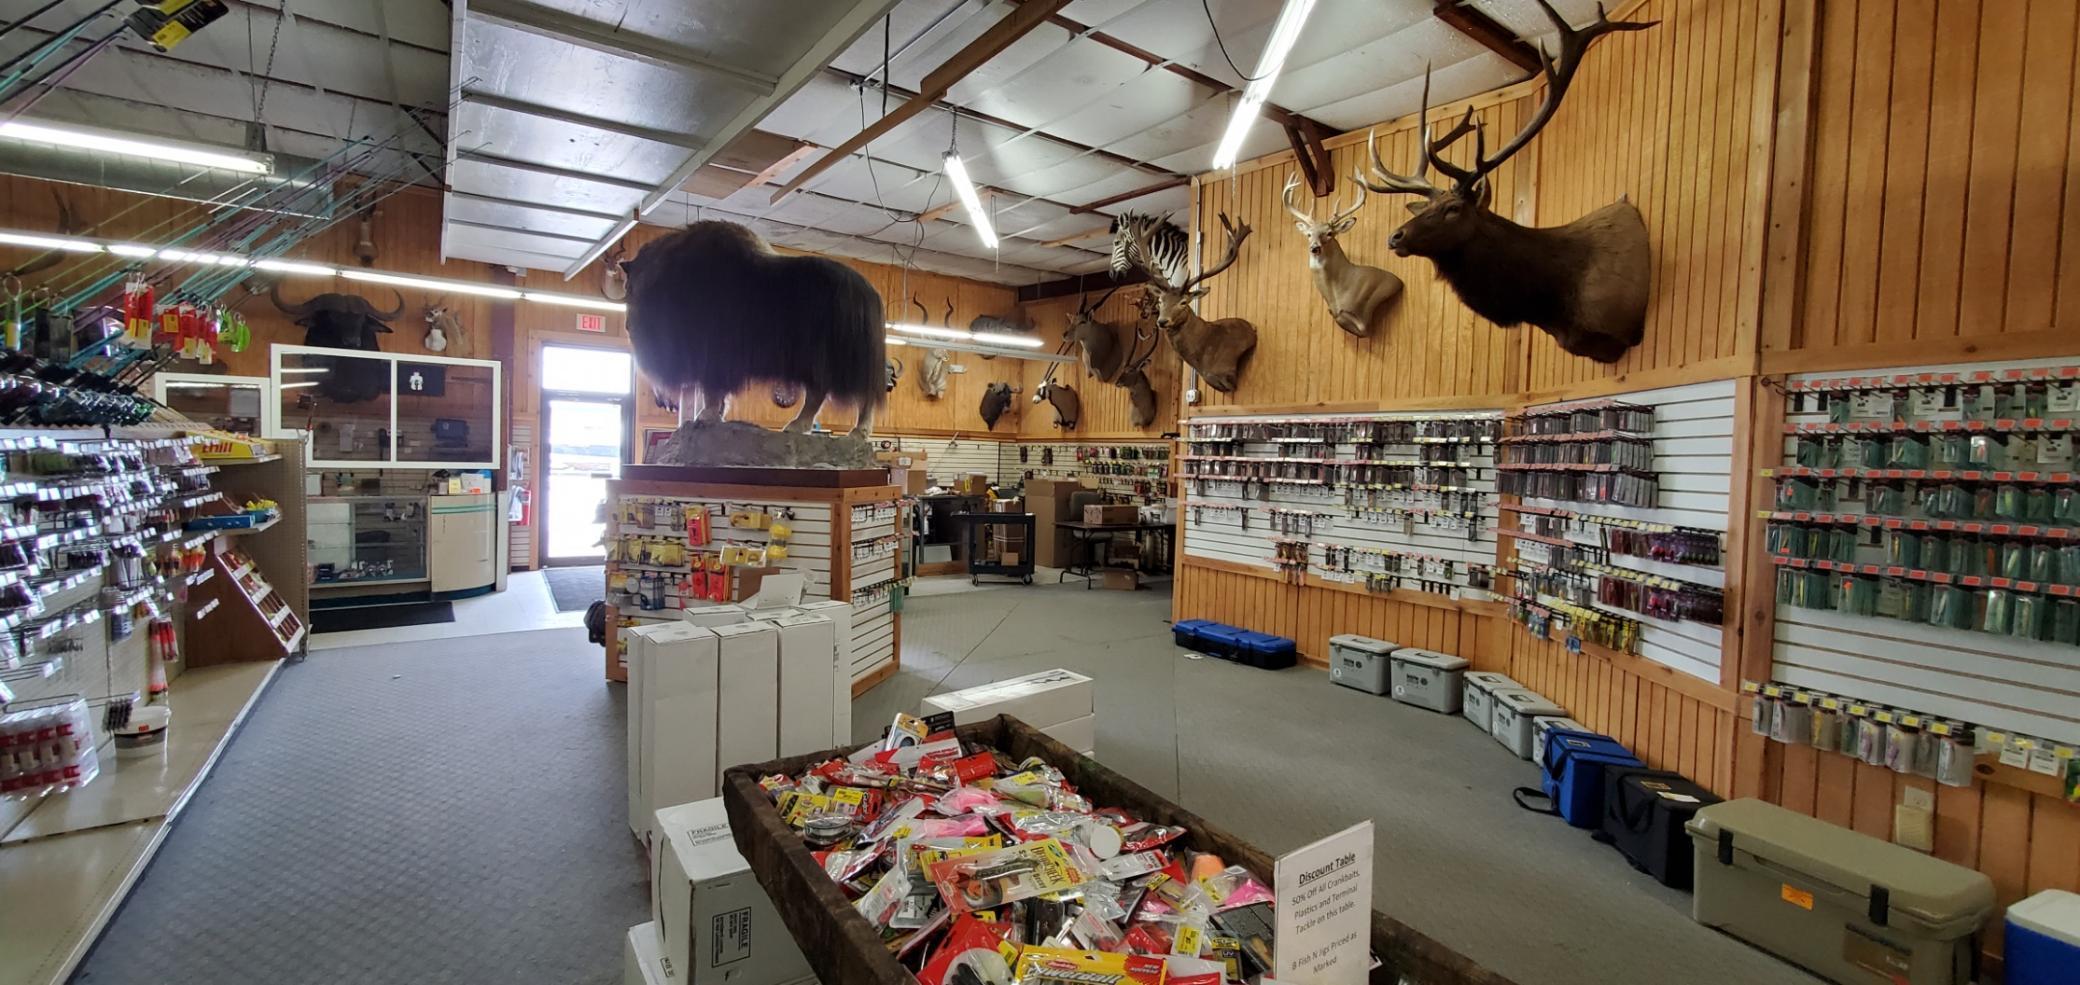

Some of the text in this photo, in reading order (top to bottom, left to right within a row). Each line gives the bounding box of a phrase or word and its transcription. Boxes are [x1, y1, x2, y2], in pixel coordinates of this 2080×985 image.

[581, 314, 601, 330] EXIT
[1299, 852, 1356, 886] Discount Table
[1291, 893, 1306, 906] 50%
[1307, 886, 1317, 899] Off
[1294, 883, 1358, 920] Plastics and Terminal
[741, 911, 749, 948] FRAGILE
[1295, 917, 1316, 935] Tackle
[1317, 914, 1326, 925] on
[1326, 907, 1338, 920] this
[1298, 953, 1312, 965] Fish
[1331, 934, 1350, 950] Priced
[1350, 931, 1358, 941] as
[1312, 956, 1337, 975] Marked
